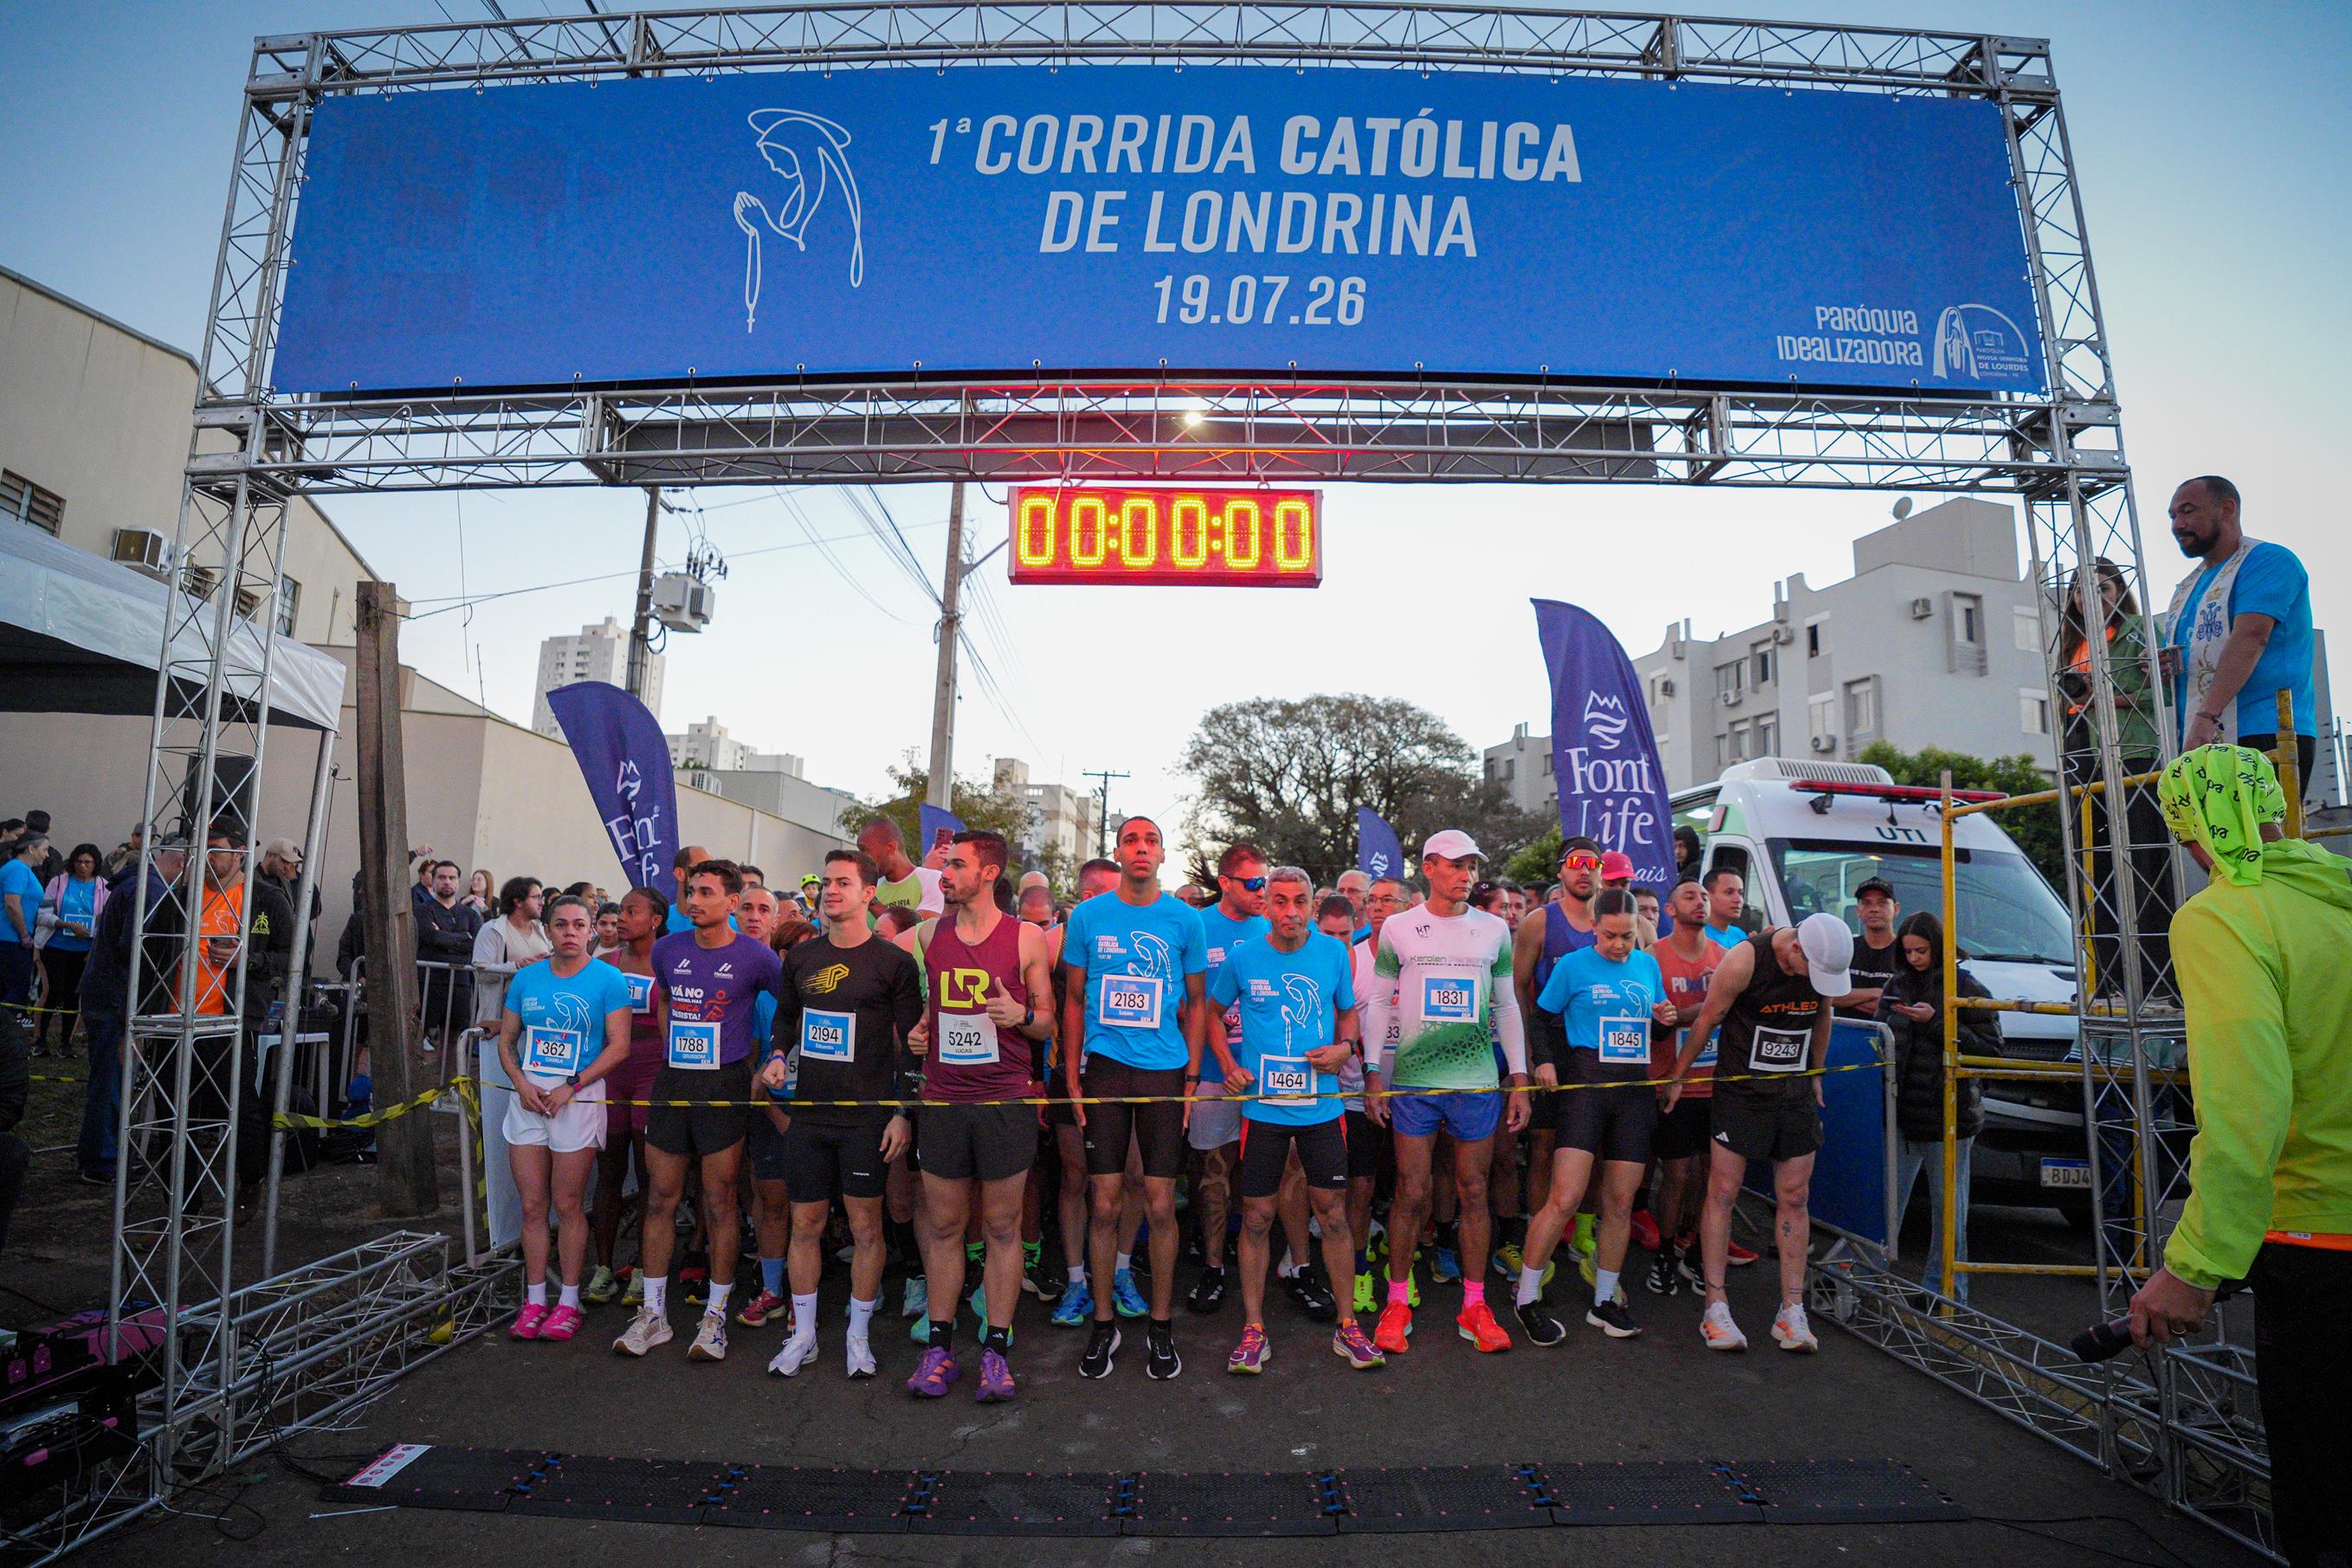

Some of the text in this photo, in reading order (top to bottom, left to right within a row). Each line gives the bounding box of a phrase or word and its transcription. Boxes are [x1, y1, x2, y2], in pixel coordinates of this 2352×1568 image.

[975, 114, 1256, 175] CORRIDA
[1280, 107, 1583, 183] CATÓLICA
[1039, 190, 1477, 257] DE LONDRINA
[1154, 274, 1367, 326] 19.07.26
[1992, 363, 2029, 371] LOURDES
[1020, 498, 1309, 568] 00:00:00
[1565, 746, 1655, 795] Font
[1580, 797, 1654, 854] Life
[1875, 826, 1928, 843] UTI
[671, 984, 704, 998] VÁ NO
[1438, 990, 1463, 1004] 1831
[1115, 992, 1145, 1009] 2183
[811, 1026, 839, 1042] 2194
[948, 1031, 982, 1047] 5242
[1612, 1032, 1639, 1046] 1845
[542, 1042, 565, 1056] 362
[679, 1037, 703, 1052] 1788
[1765, 1042, 1798, 1056] 9243
[1271, 1072, 1303, 1087] 1464
